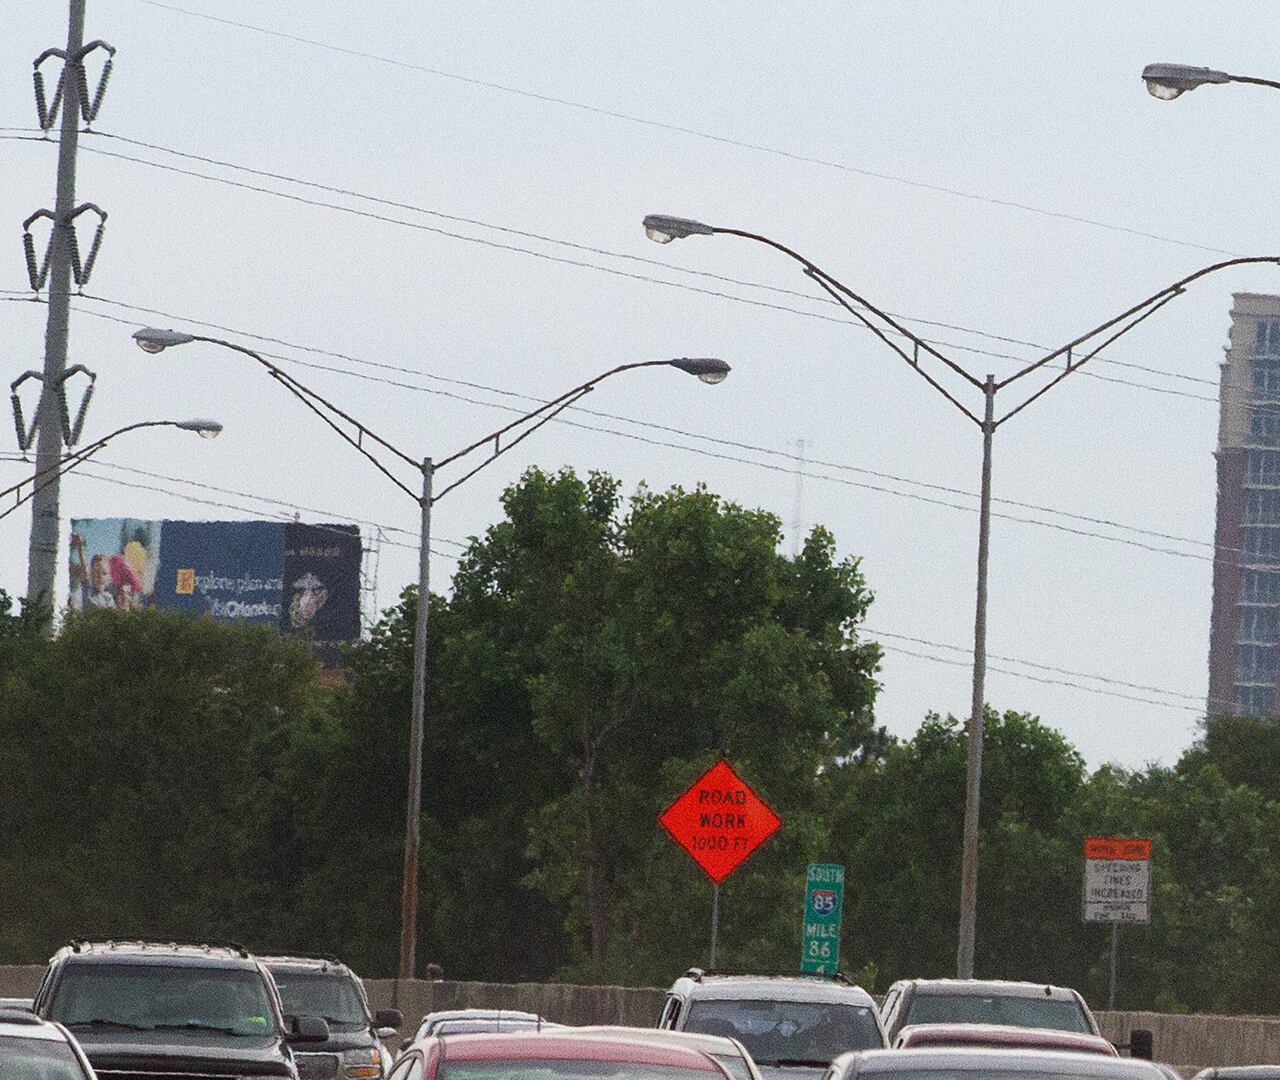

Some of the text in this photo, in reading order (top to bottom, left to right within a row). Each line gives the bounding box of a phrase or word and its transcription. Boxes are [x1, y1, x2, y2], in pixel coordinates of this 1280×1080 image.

[698, 789, 747, 806] ROAD
[699, 812, 747, 829] WORK
[734, 836, 749, 850] FT
[809, 867, 844, 883] SOUTH
[813, 894, 835, 911] 85
[806, 923, 837, 938] MILE
[809, 940, 831, 957] 86
